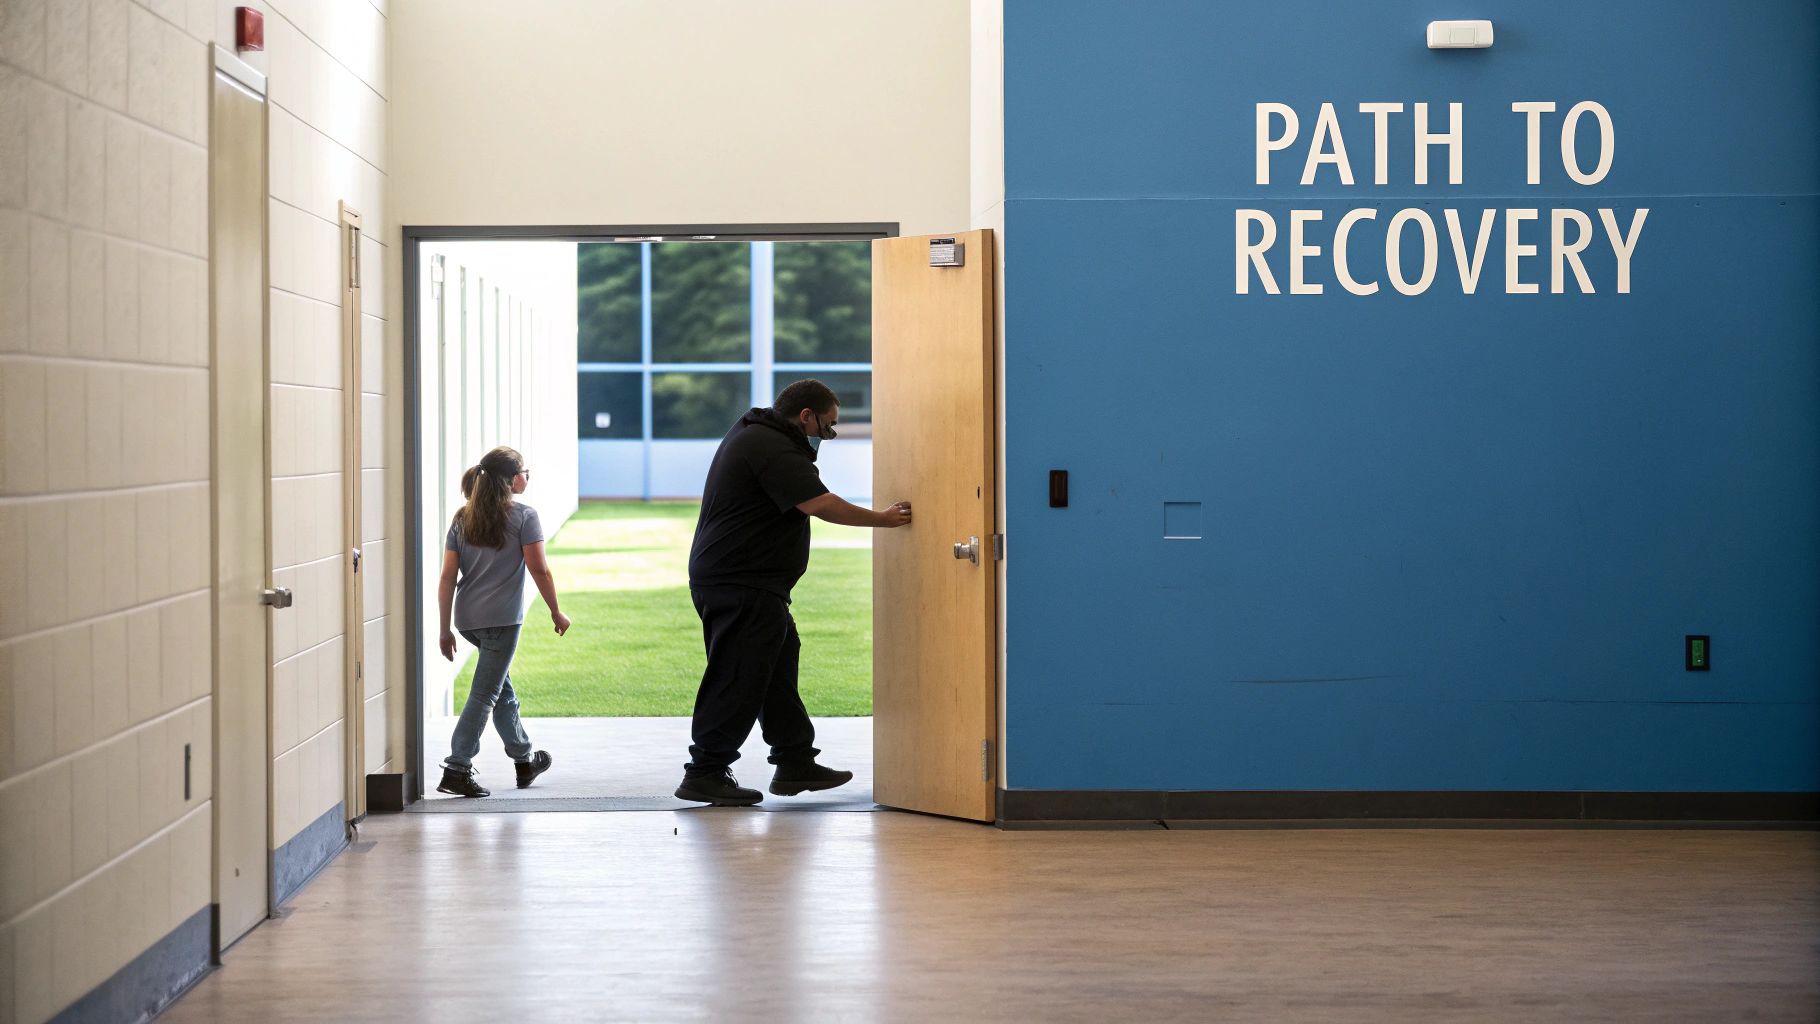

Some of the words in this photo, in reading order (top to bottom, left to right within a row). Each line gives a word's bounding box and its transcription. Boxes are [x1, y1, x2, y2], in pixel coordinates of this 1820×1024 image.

[1255, 101, 1463, 186] PATH
[1511, 100, 1615, 186] TO
[1235, 207, 1650, 295] RECOVERY
